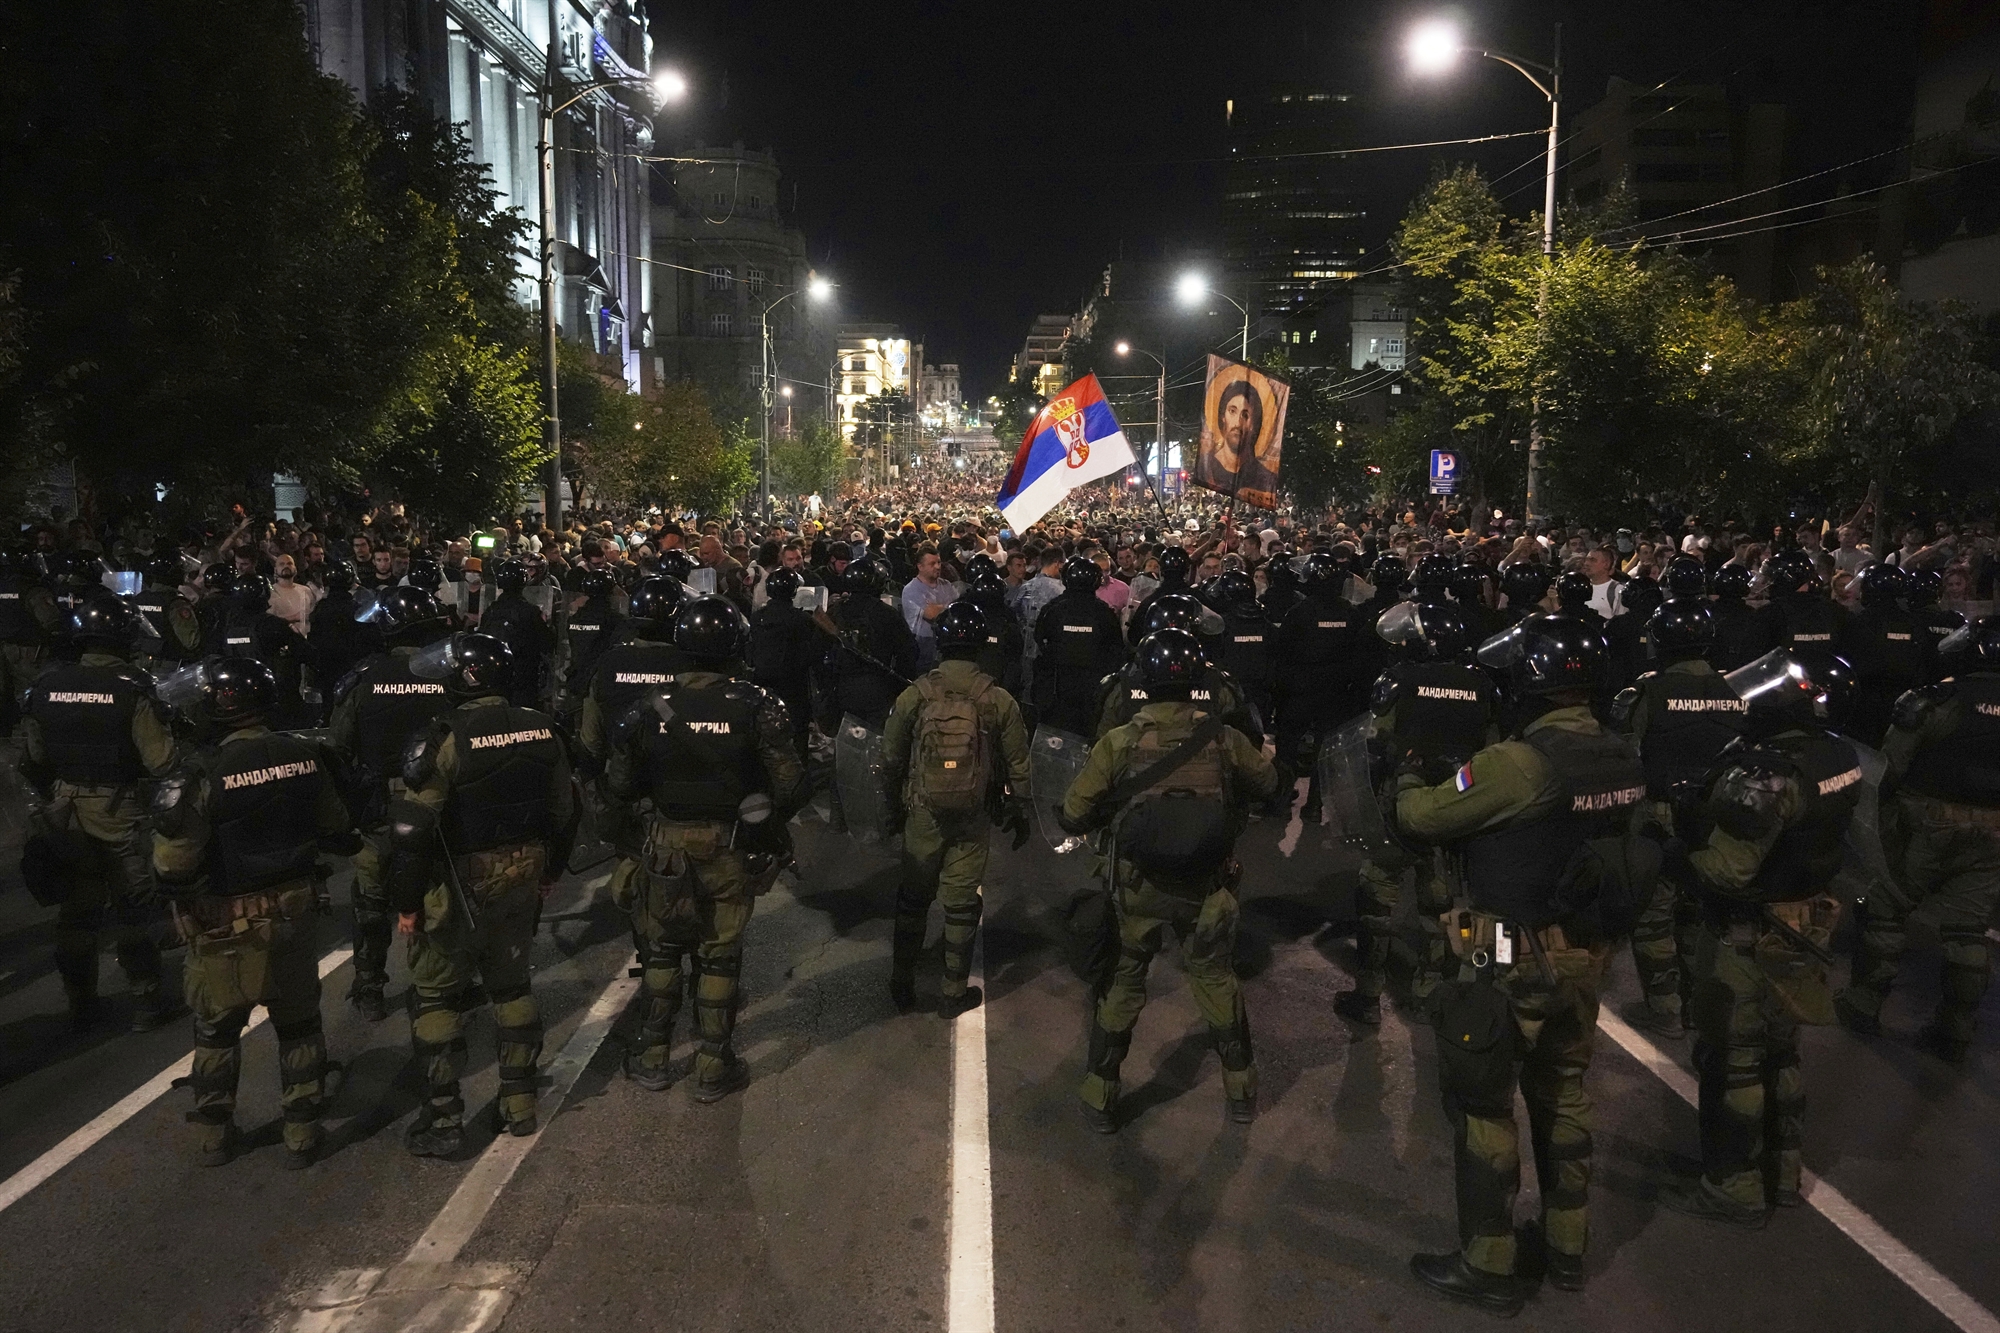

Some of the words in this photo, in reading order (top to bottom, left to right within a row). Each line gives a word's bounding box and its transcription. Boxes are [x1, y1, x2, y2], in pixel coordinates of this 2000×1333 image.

[373, 683, 444, 694] ЖАНДАРМЕРИ
[1417, 686, 1477, 701] ЖАНДАРМЕРИЈА
[49, 692, 114, 704] ЖАНДАРМЕРИЈА
[470, 728, 553, 750] ЖАНДАРМЕРИЈА
[223, 759, 318, 790] ЖАНДАРМЕРИЈА
